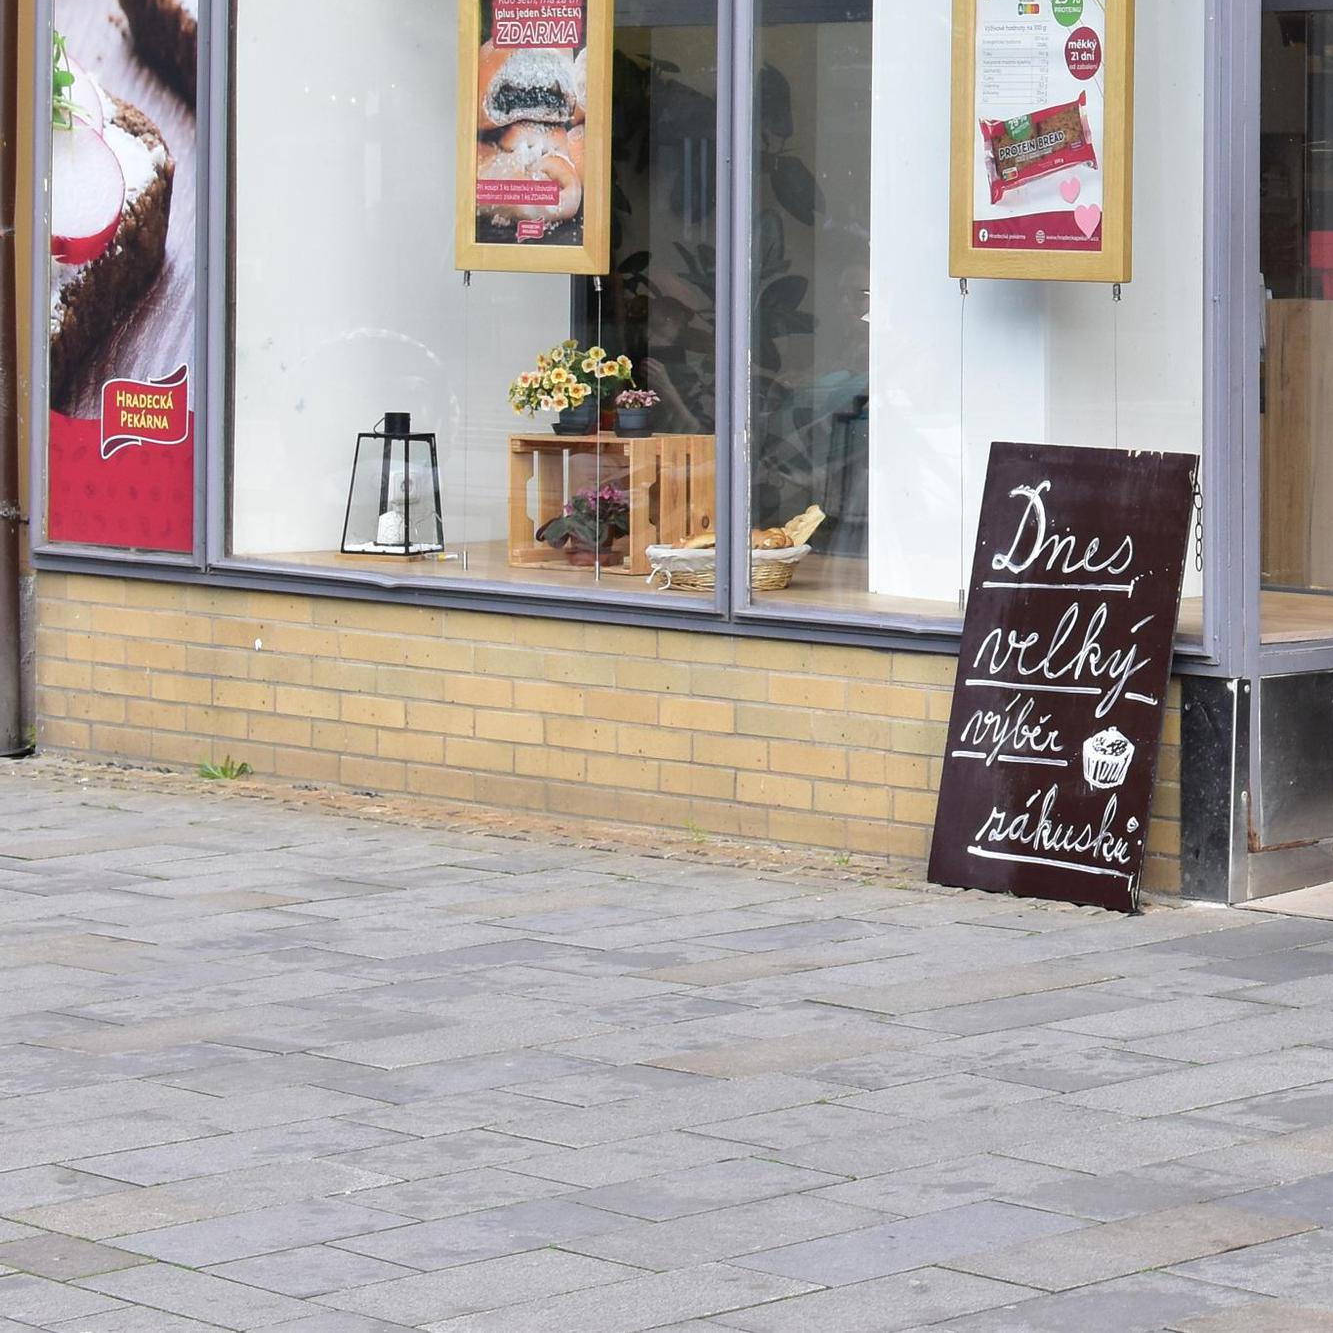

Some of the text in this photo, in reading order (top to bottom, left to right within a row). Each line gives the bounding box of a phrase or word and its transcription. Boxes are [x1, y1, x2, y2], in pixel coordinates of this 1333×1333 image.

[495, 7, 515, 20] (plus
[516, 7, 540, 20] jeden
[496, 20, 579, 44] ZDARMA
[1068, 39, 1097, 51] měkký
[1070, 51, 1095, 61] 21 dní
[999, 139, 1036, 161] PROTEIN
[1037, 130, 1065, 149] BREAD
[116, 389, 174, 410] HRADECKÁ
[120, 409, 169, 430] PEKÁRNA
[992, 480, 1134, 575] Dnes
[973, 602, 1156, 718] velký
